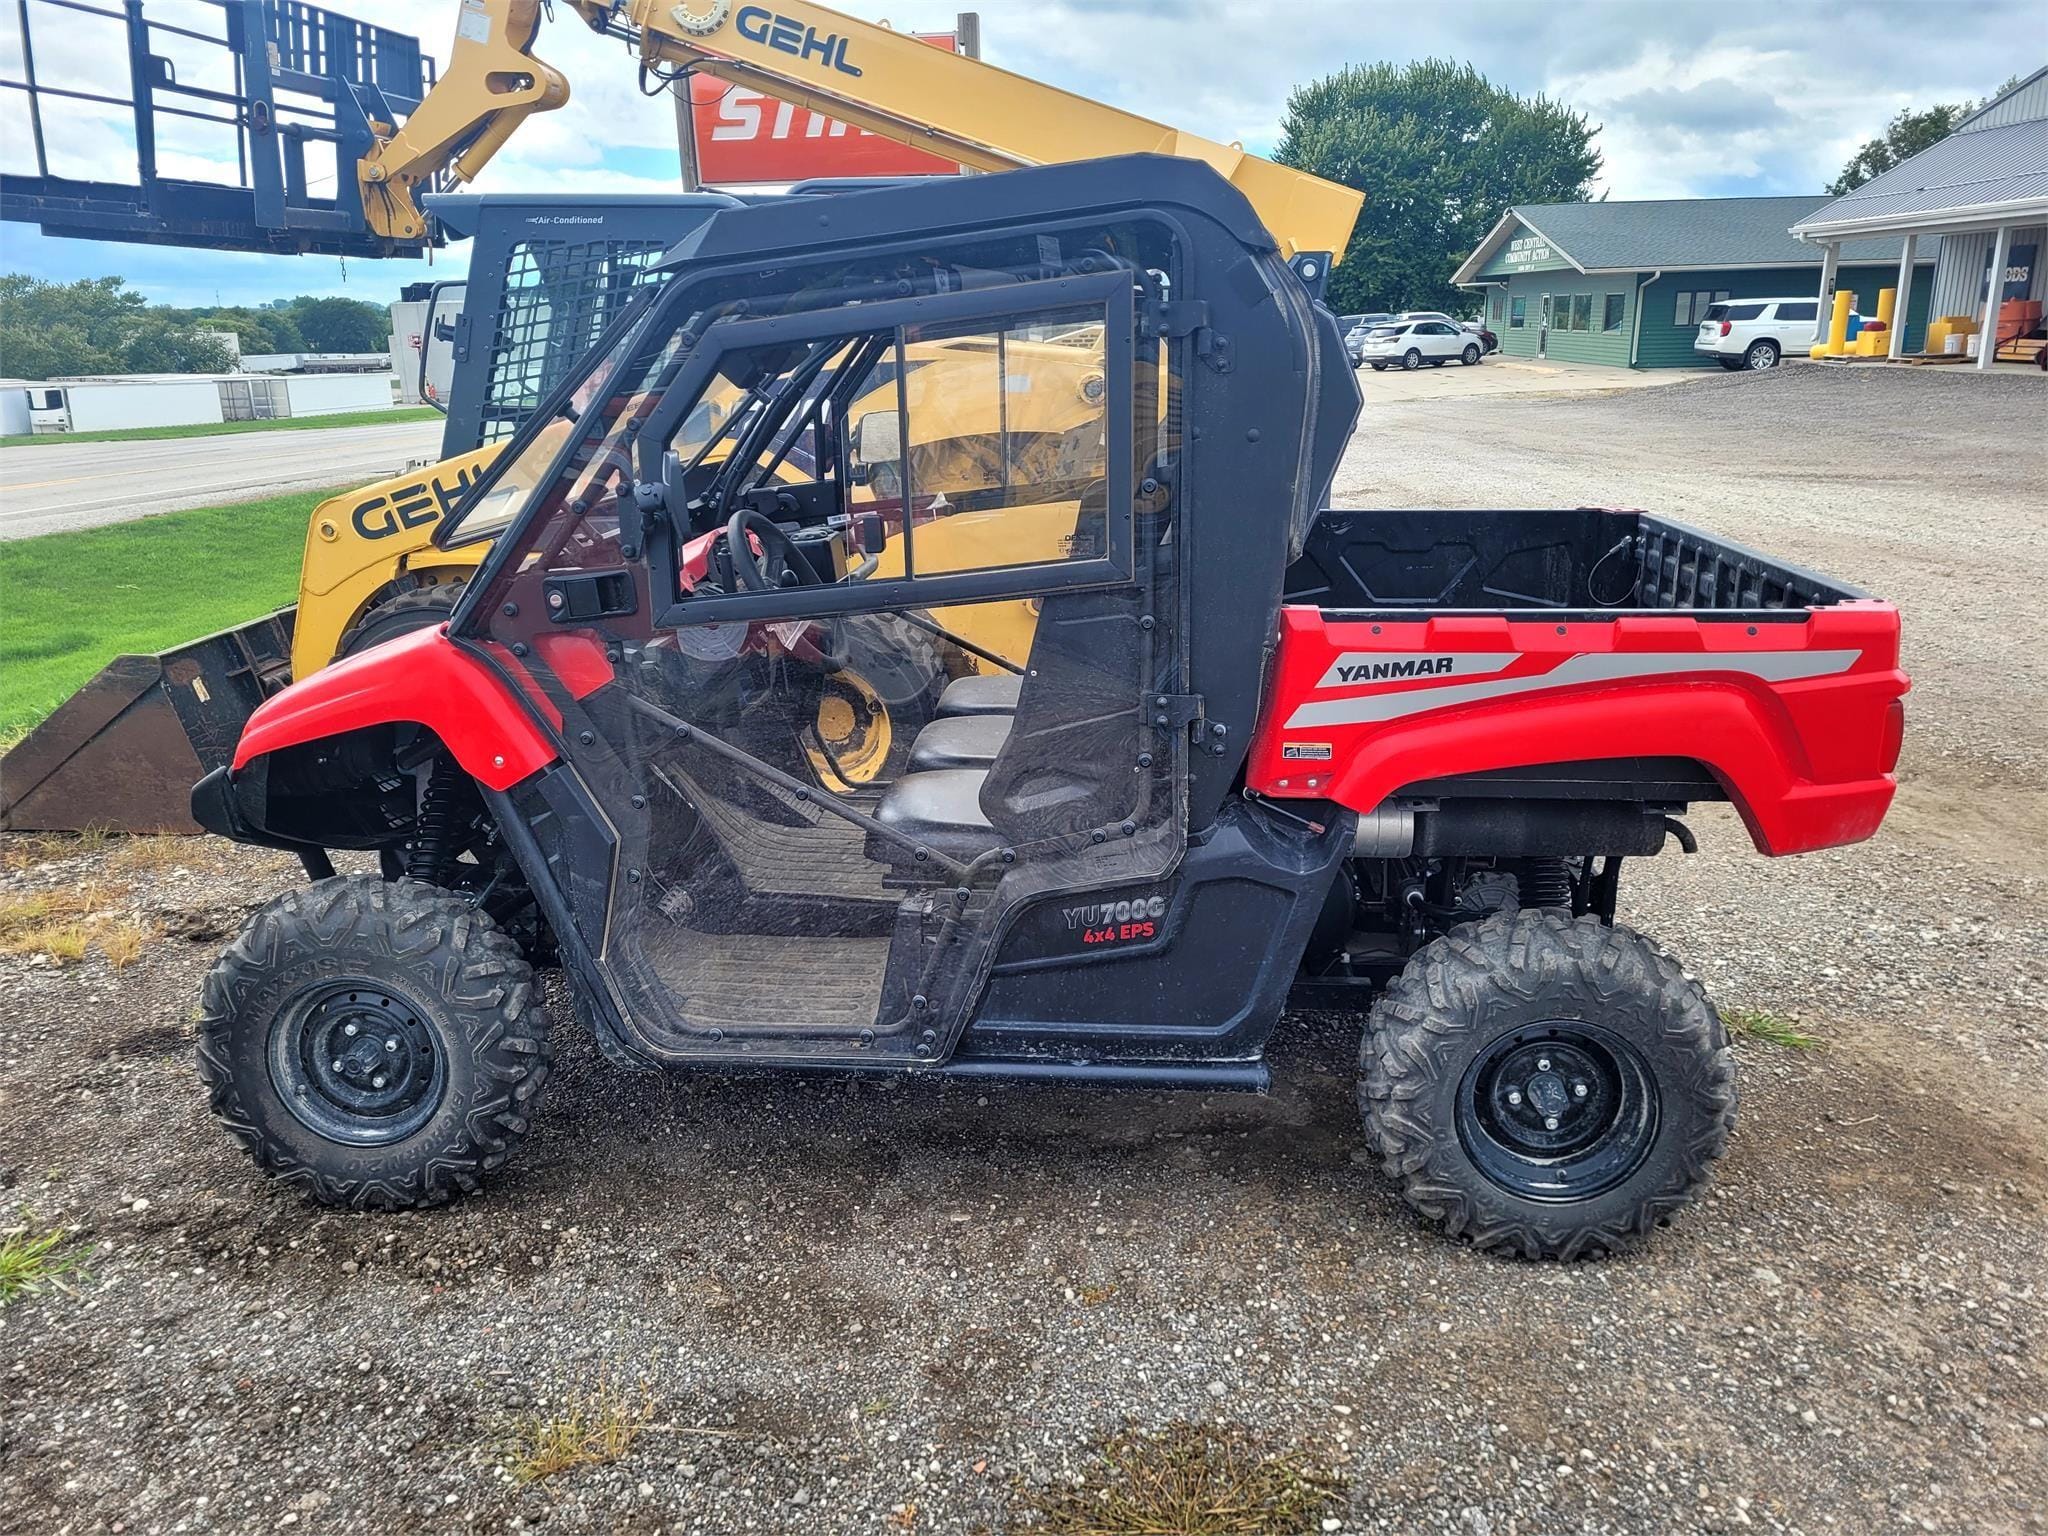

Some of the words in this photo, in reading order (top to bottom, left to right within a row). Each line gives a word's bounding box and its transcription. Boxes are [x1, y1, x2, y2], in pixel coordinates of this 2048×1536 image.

[735, 5, 863, 77] GEHL
[538, 216, 603, 224] Air-Conditioned
[1986, 267, 2029, 282] ODS
[1337, 657, 1453, 682] YANMAR
[1062, 896, 1165, 930] YU700G
[1083, 927, 1115, 944] 4x4
[1120, 922, 1154, 939] EPS
